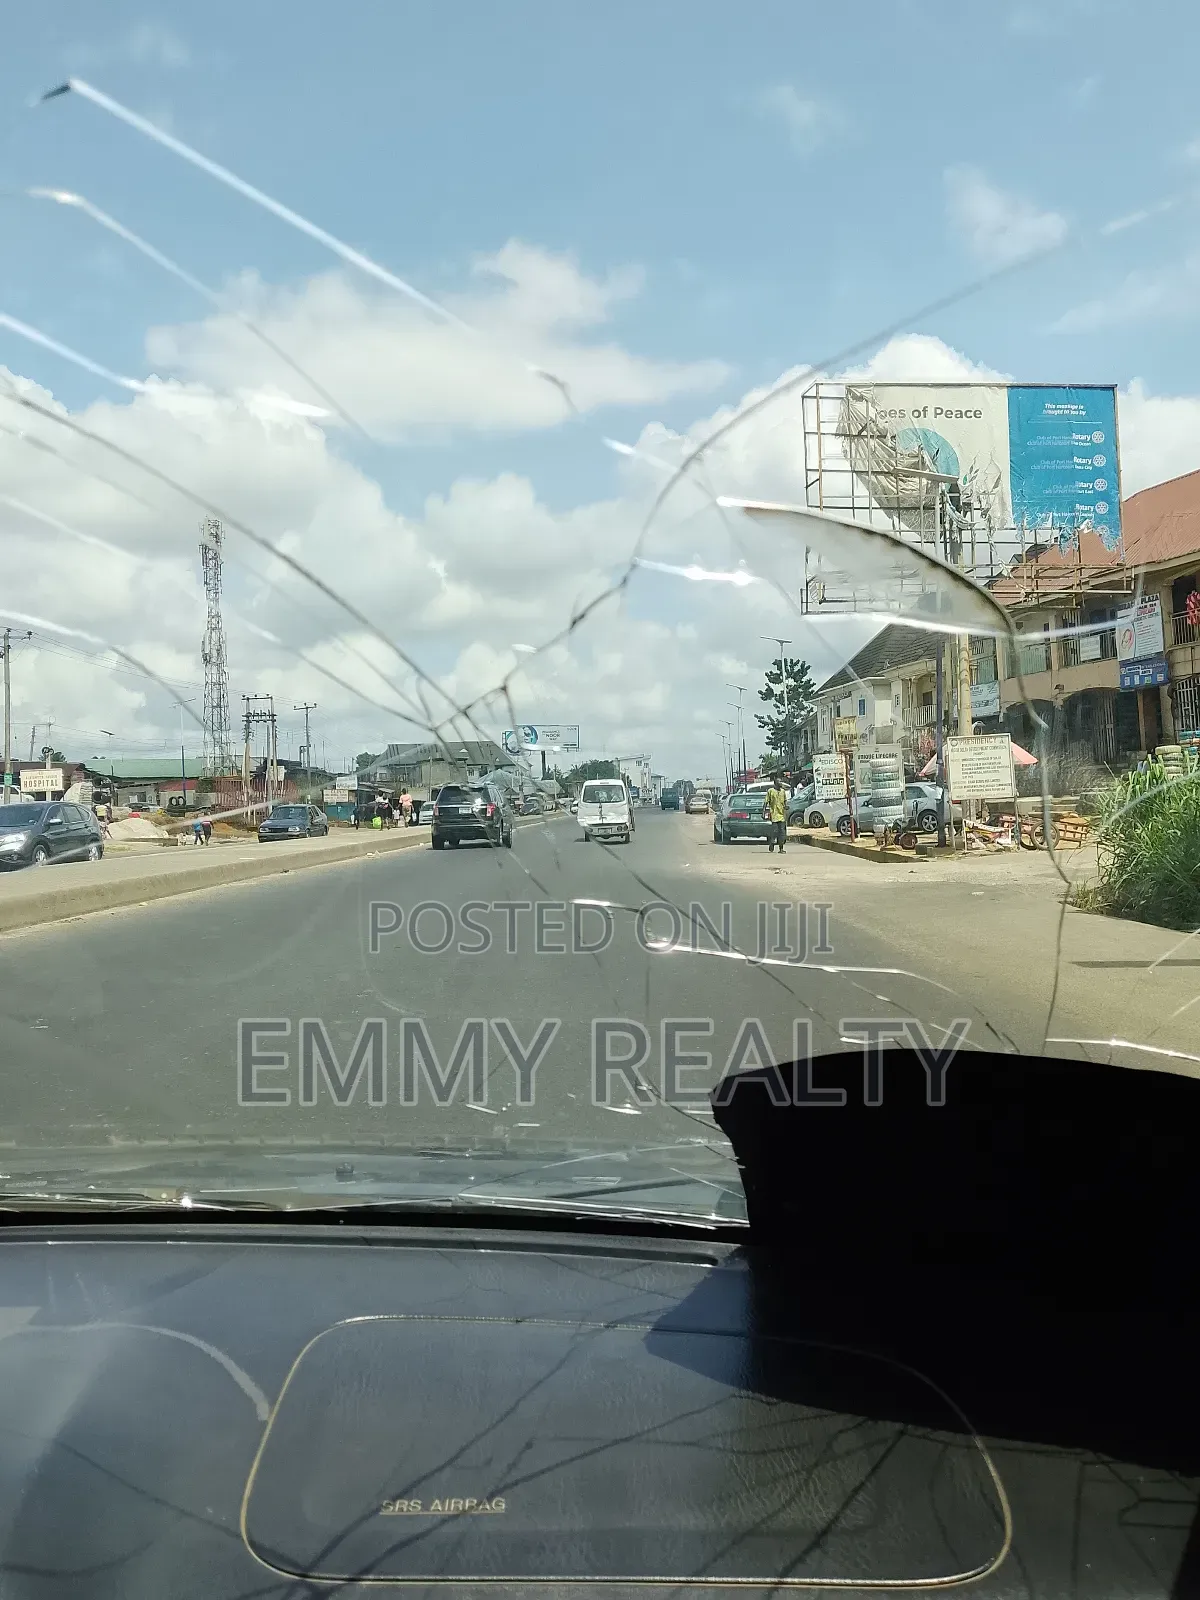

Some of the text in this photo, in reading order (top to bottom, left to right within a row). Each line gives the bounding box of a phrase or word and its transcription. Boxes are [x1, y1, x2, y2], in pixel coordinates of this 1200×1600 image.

[911, 405, 929, 419] of
[933, 406, 983, 419] Peace
[1073, 456, 1092, 465] Rotary
[1140, 594, 1160, 605] PLAZA
[960, 737, 997, 746] PRESIDENCY
[23, 780, 59, 788] HOSPITAL
[381, 1499, 423, 1513] SRS
